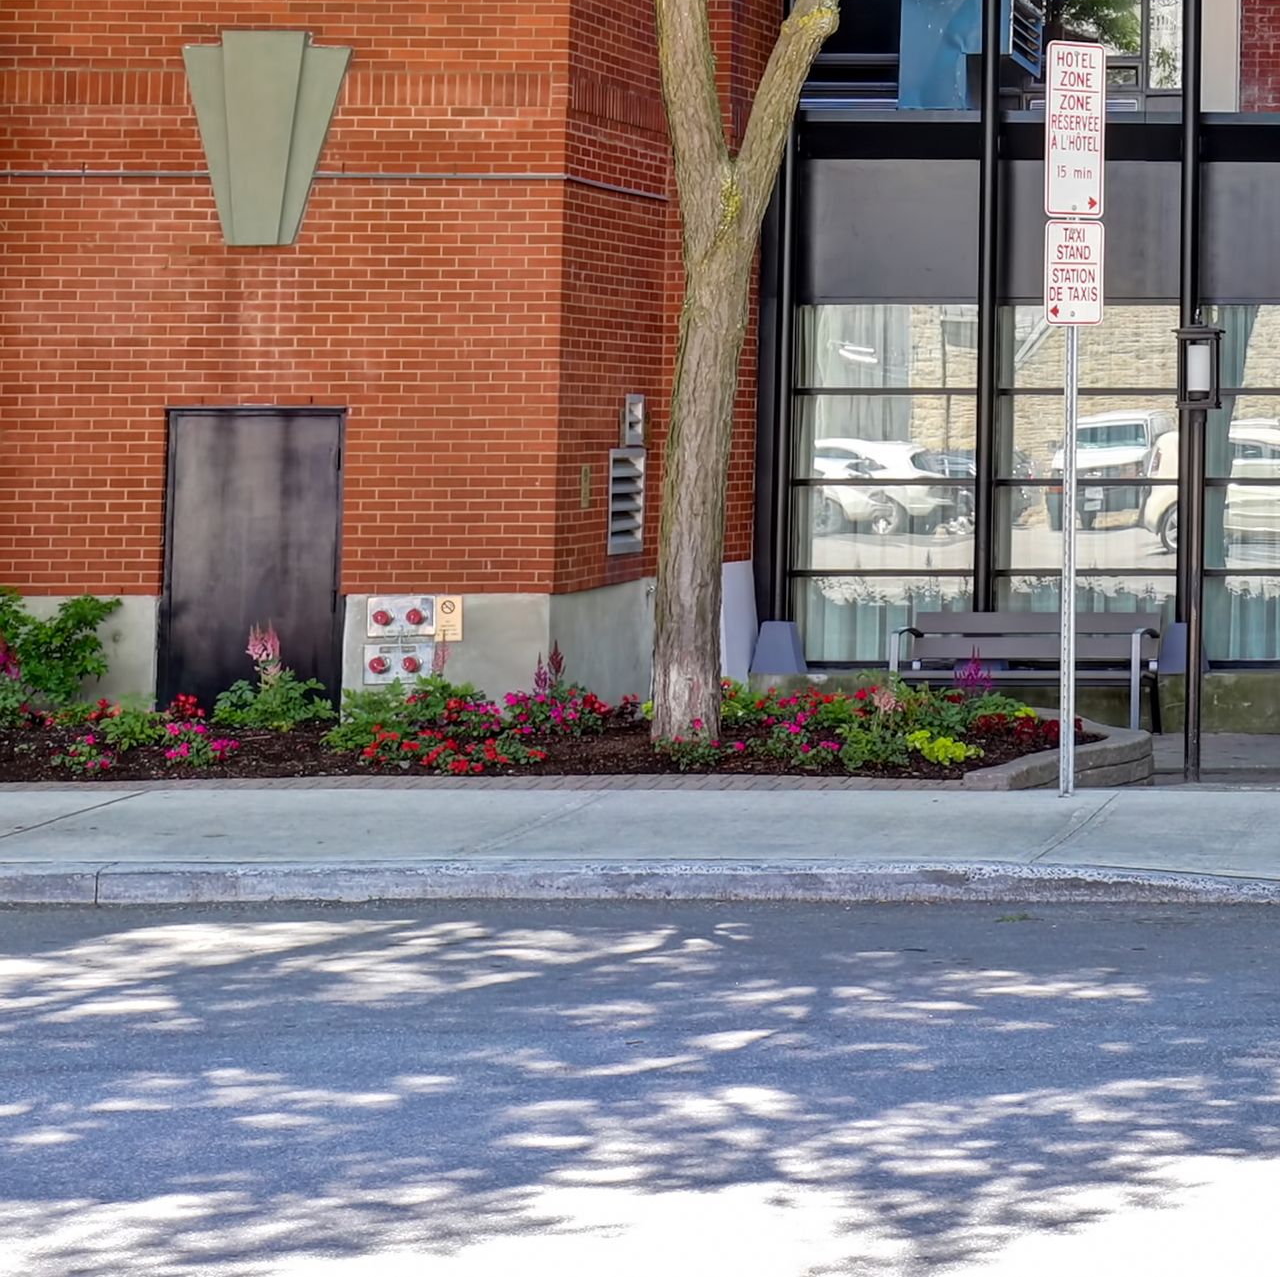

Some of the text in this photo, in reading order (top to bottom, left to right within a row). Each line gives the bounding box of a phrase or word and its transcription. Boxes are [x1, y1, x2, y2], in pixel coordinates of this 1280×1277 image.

[1057, 51, 1096, 69] HOTEL
[1060, 71, 1092, 88] ZONE
[1059, 94, 1092, 111] ZONE
[1051, 111, 1099, 132] RÉSERVÉE
[1051, 131, 1099, 152] À L'HÔTEL
[1057, 165, 1093, 179] 15 min
[1063, 228, 1085, 242] TAXI
[1056, 244, 1091, 260] STAND
[1052, 267, 1095, 284] STATION
[1049, 286, 1098, 302] DE TAXIS
